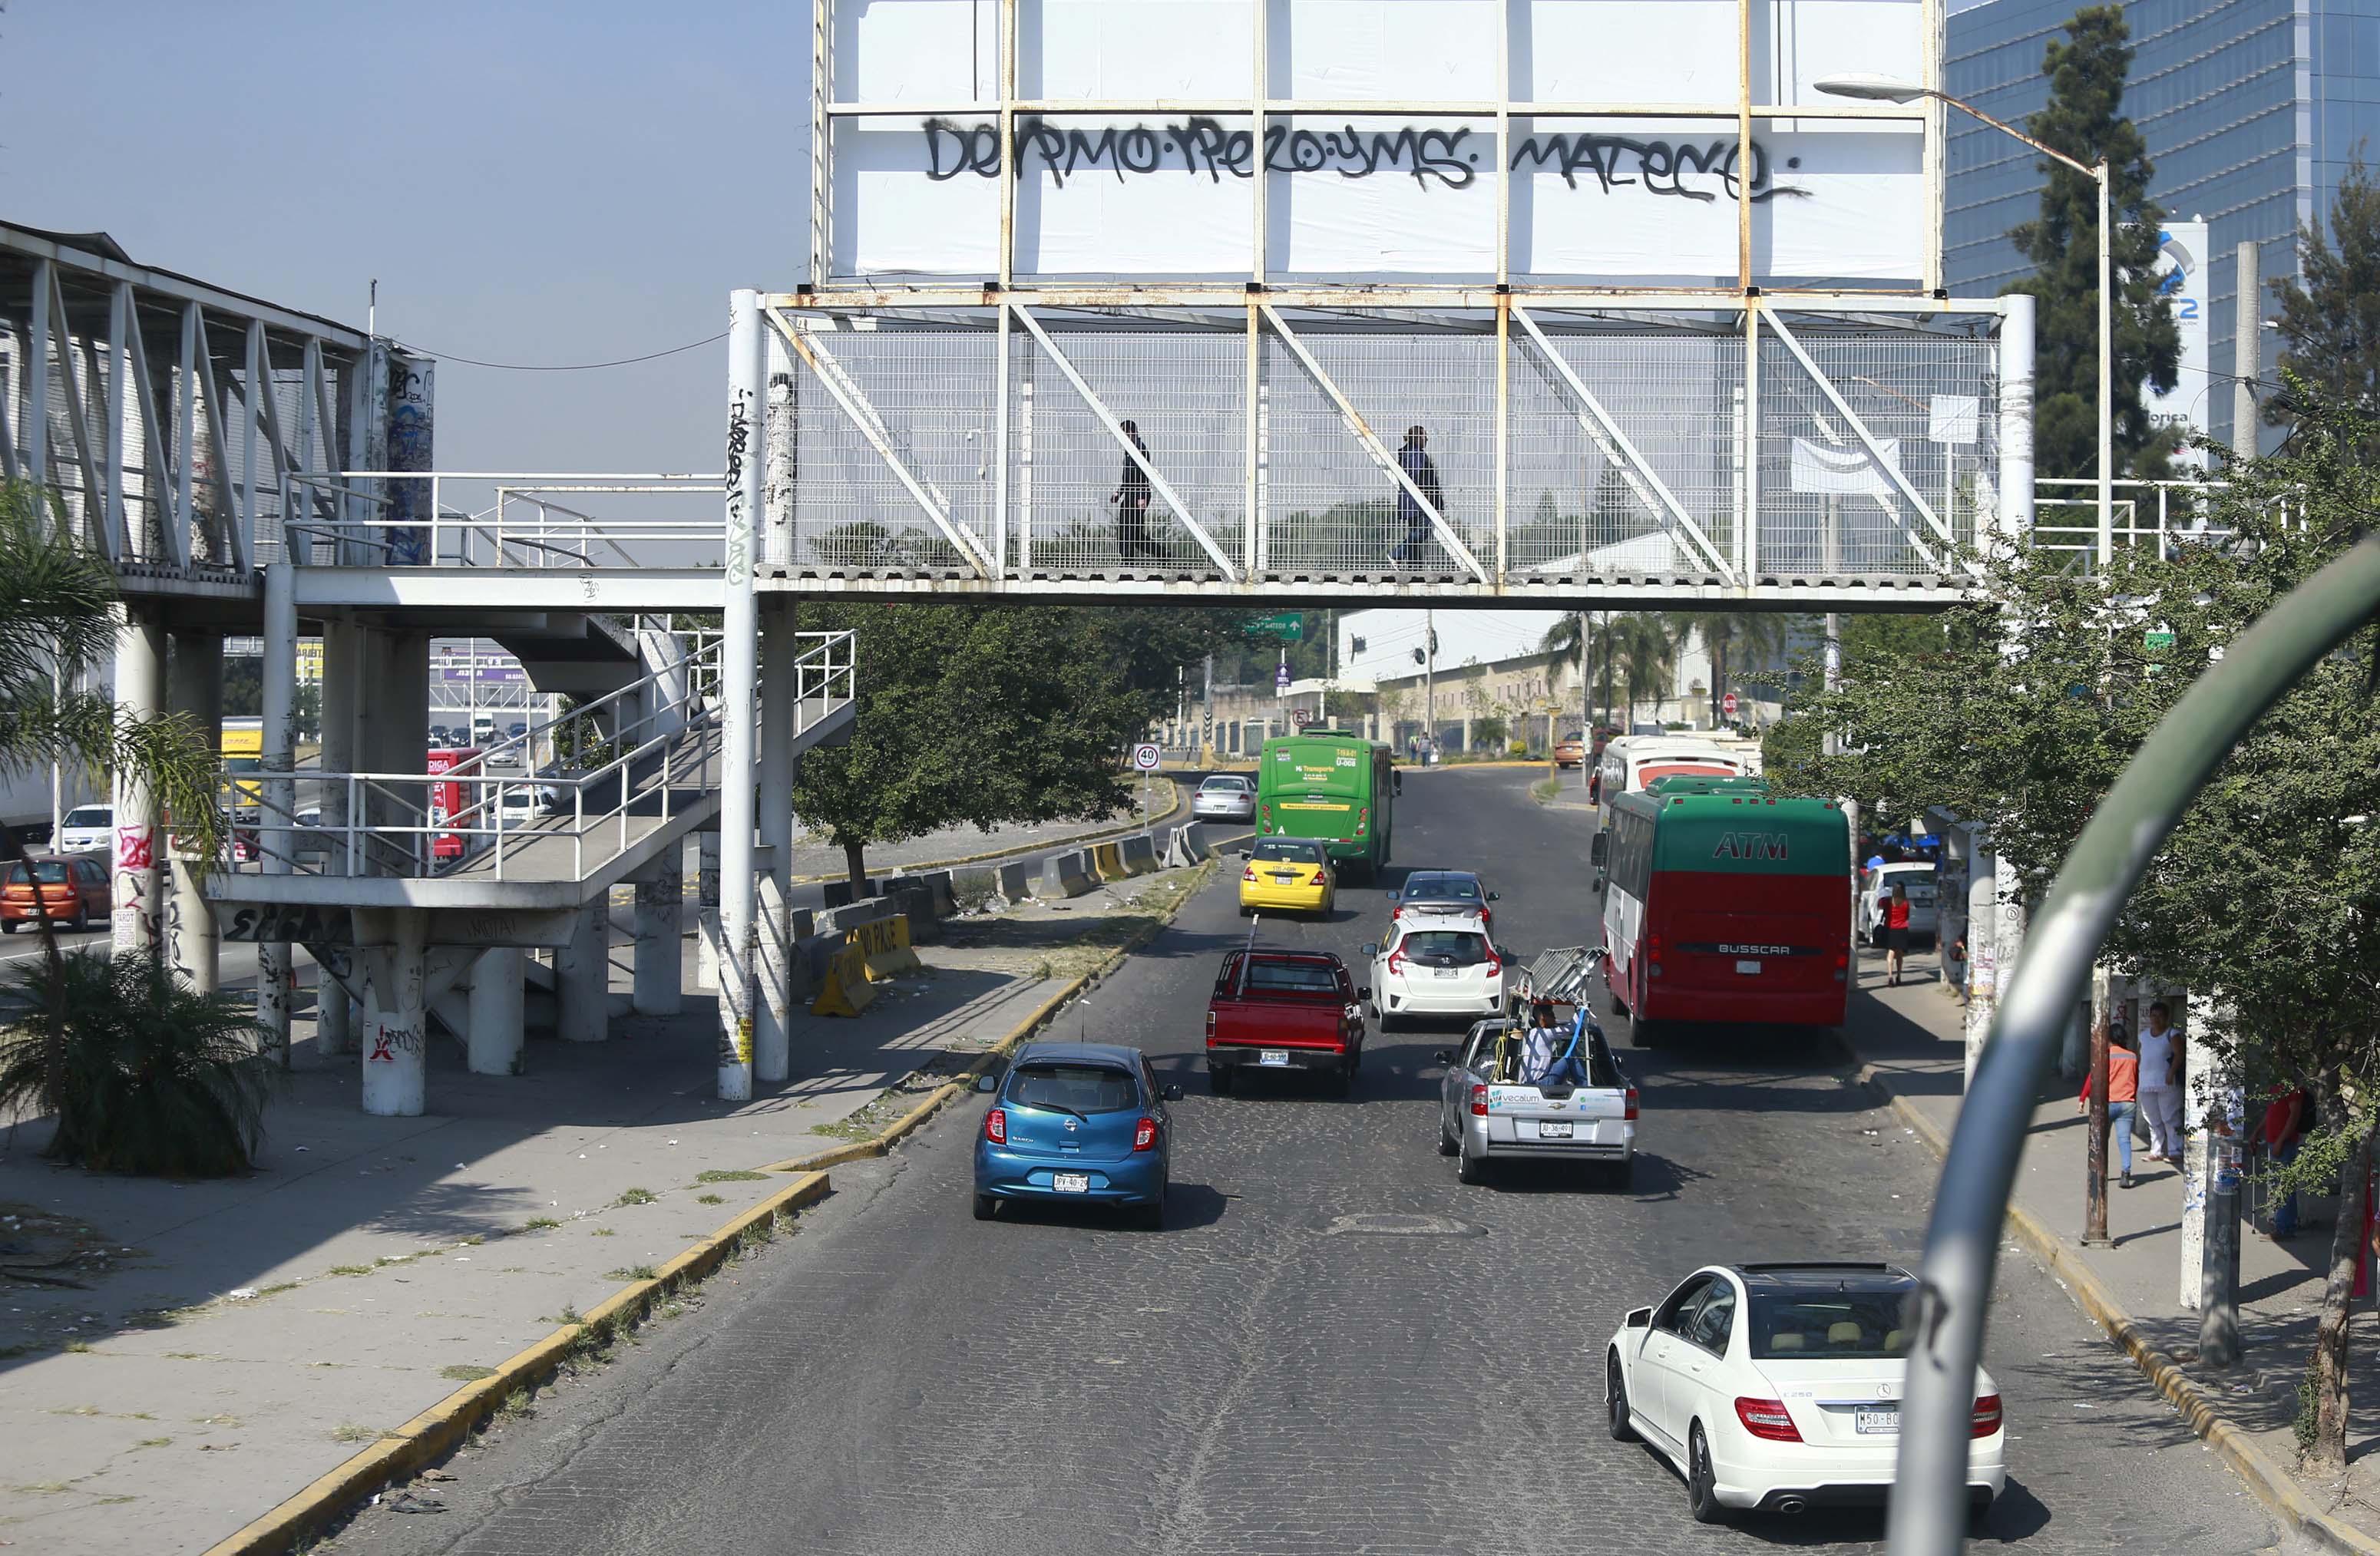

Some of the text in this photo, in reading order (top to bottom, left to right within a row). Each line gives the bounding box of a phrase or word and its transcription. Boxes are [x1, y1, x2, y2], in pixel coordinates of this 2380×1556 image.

[1724, 699, 1737, 709] ALTO
[1141, 749, 1154, 759] 40
[1278, 825, 1285, 835] A
[1713, 831, 1788, 860] ATM
[1719, 944, 1790, 955] BUSSCAR
[1502, 1093, 1539, 1102] vecalum
